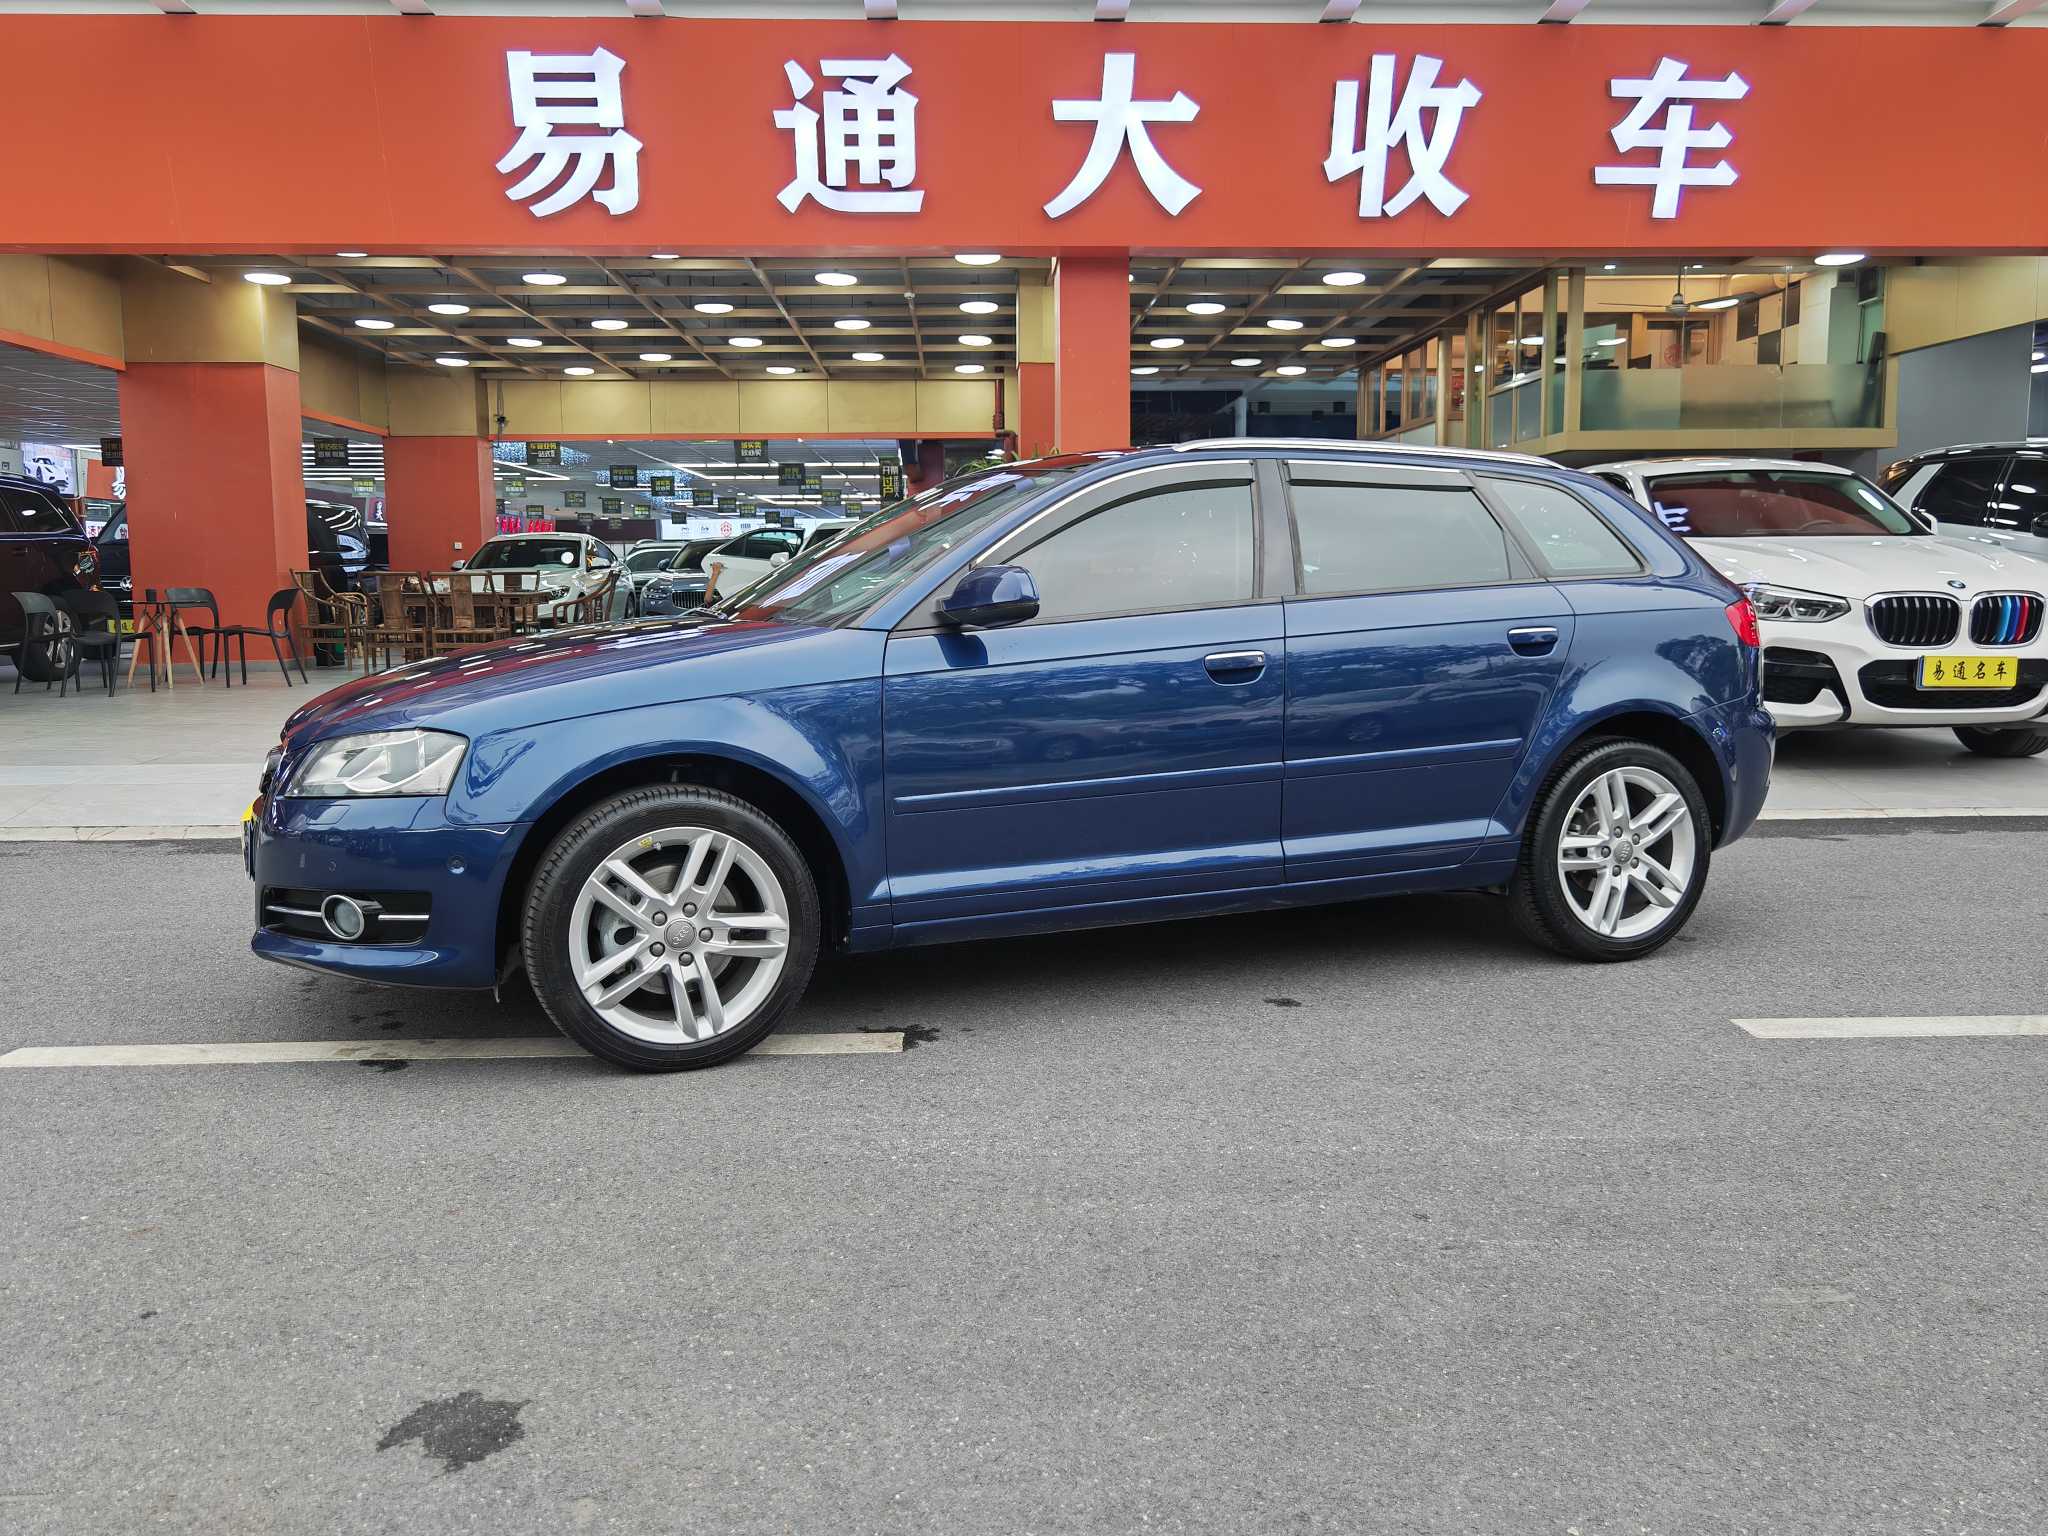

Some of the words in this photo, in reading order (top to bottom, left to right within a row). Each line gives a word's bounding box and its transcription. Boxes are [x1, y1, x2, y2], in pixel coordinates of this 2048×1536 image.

[495, 46, 1749, 219] 易通大收车
[1932, 659, 2008, 681] 易通名车
